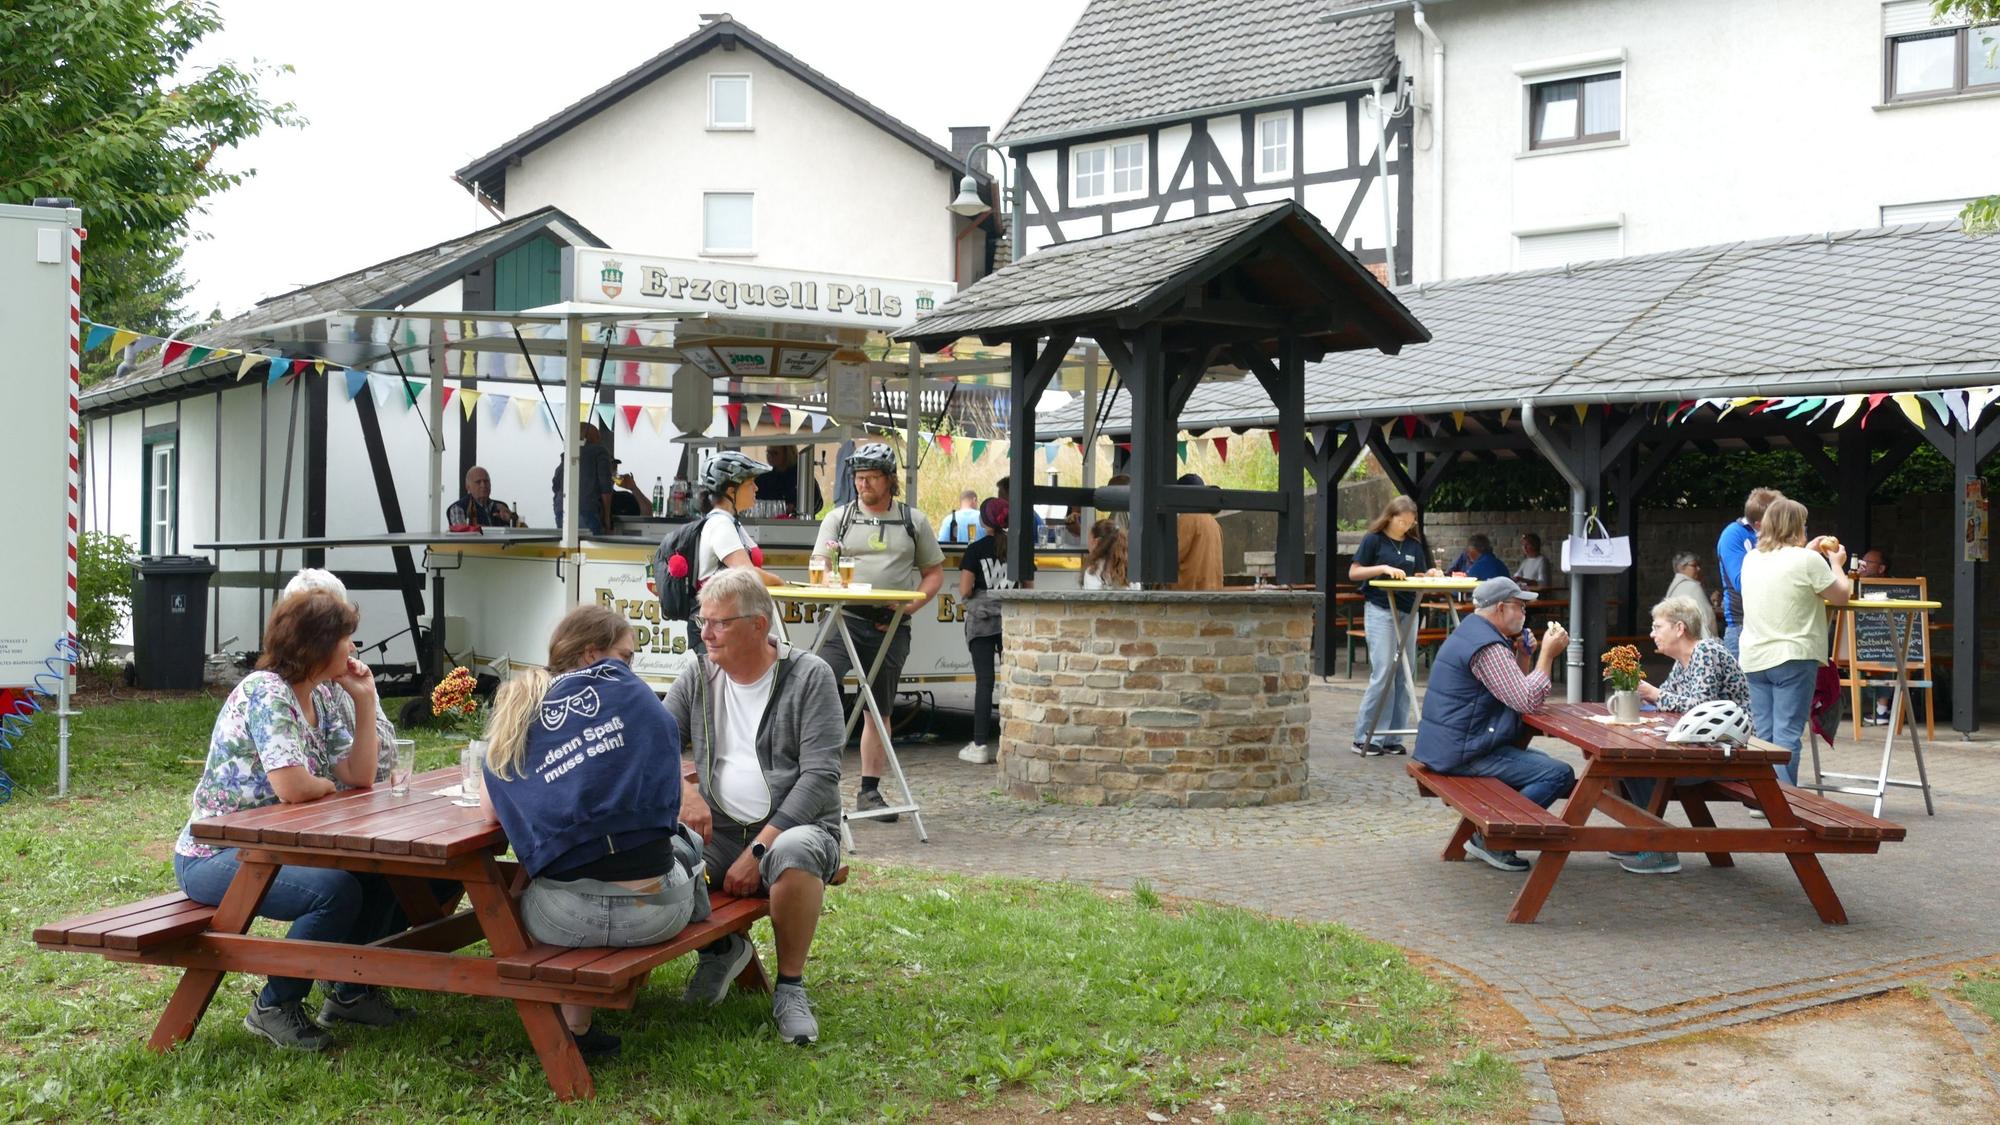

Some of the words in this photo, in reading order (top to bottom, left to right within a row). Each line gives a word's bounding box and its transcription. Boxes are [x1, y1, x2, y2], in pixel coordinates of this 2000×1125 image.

[640, 265, 819, 310] Erzquell
[827, 282, 902, 317] Pils
[632, 625, 687, 655] Pils
[583, 716, 625, 741] Spaß
[544, 752, 585, 784] muss
[586, 732, 625, 757] sein!
